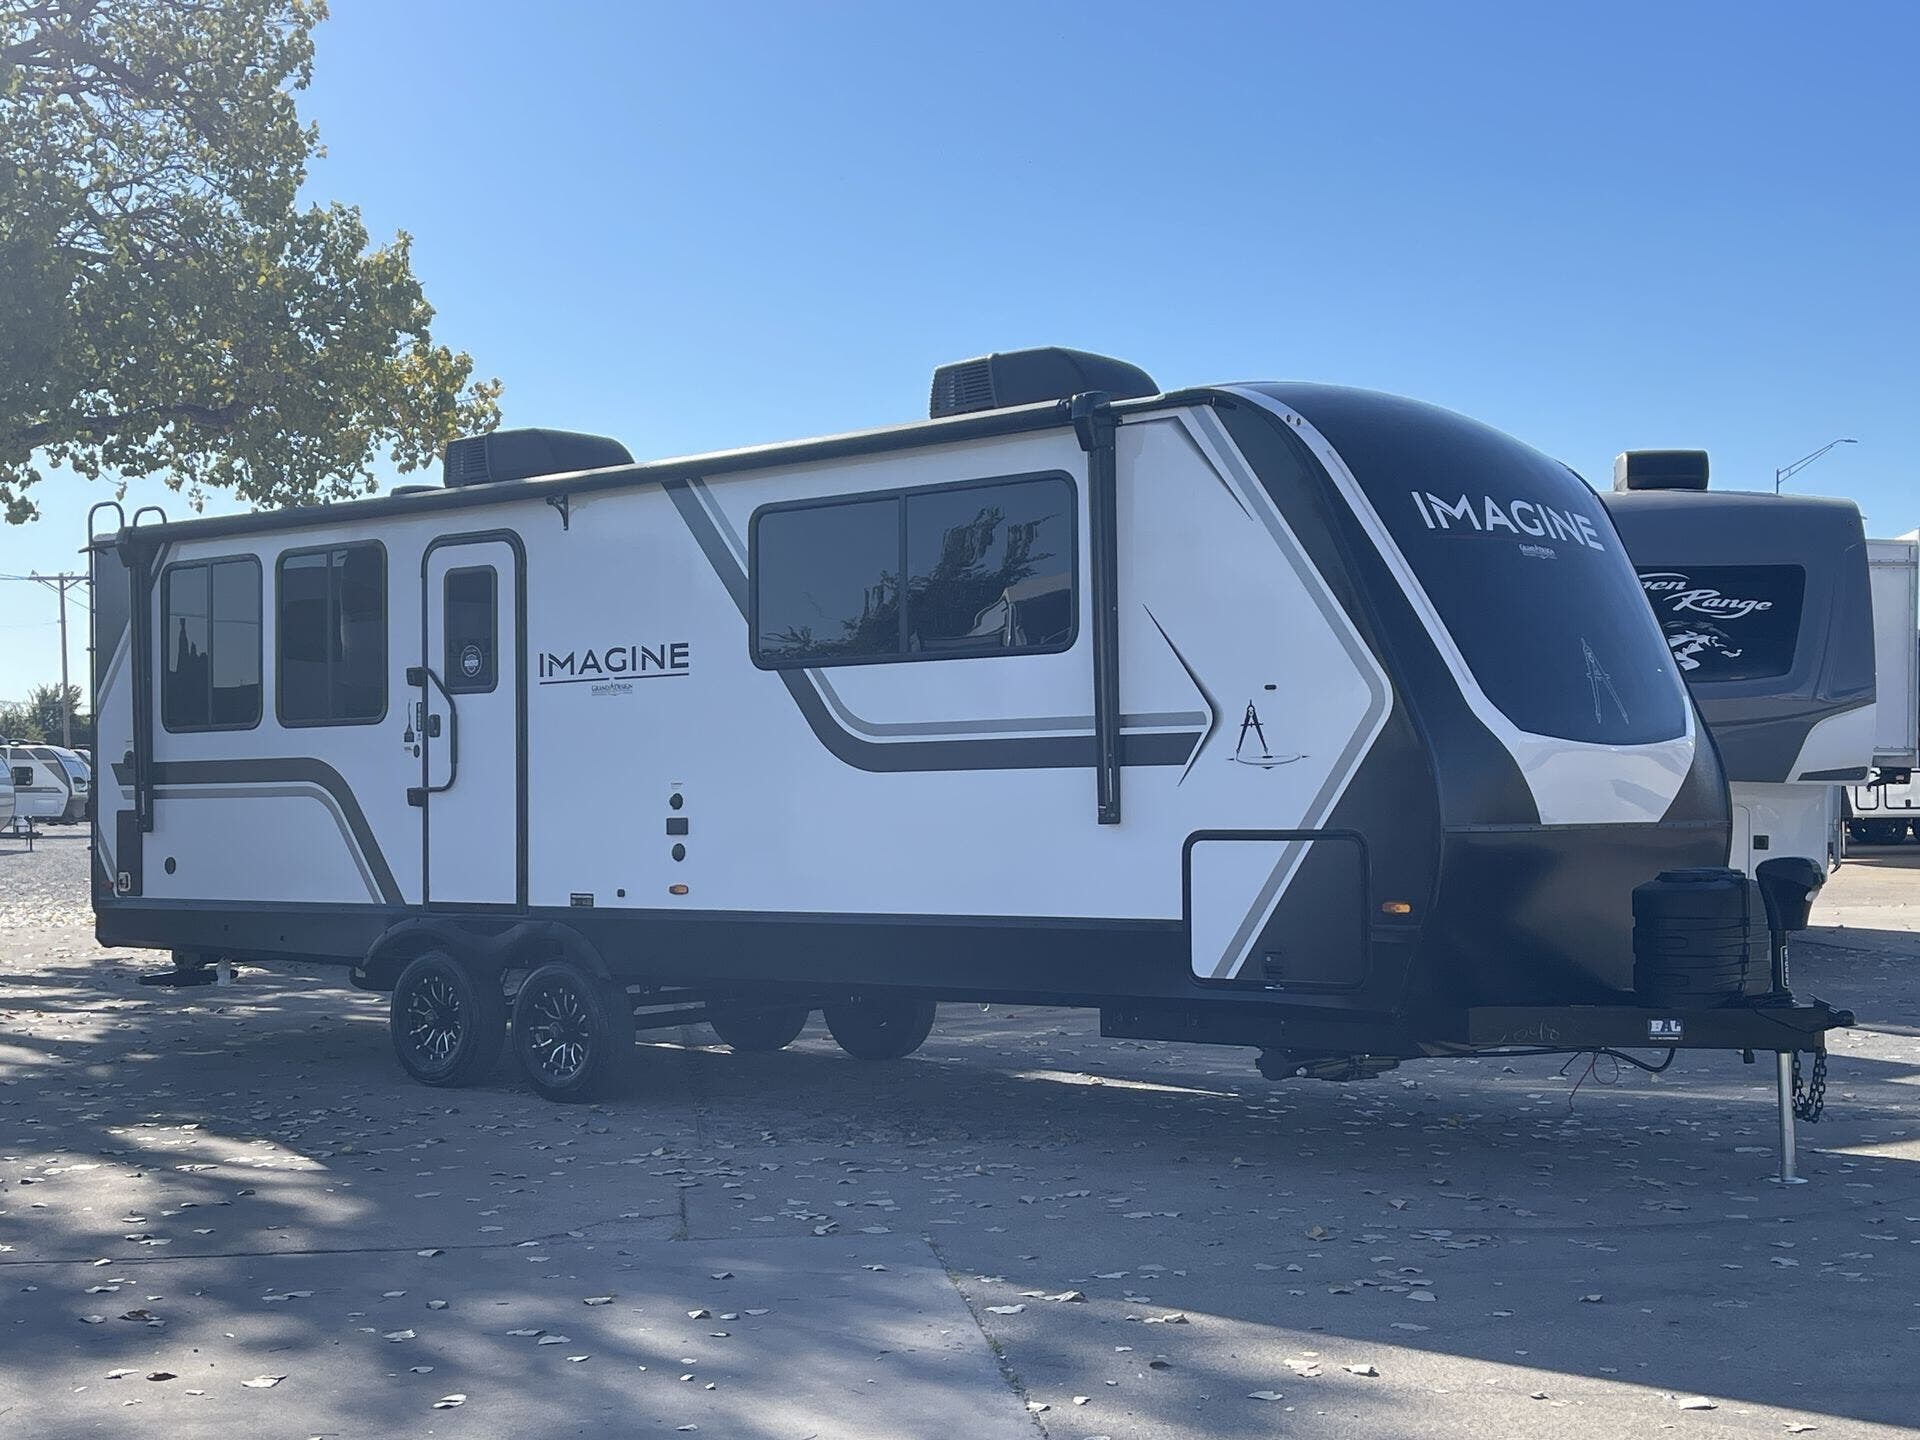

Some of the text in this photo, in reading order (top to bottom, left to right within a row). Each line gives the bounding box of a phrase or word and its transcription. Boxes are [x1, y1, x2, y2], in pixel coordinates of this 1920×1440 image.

[1411, 491, 1605, 551] IMAGINE
[1663, 589, 1773, 619] Range
[539, 642, 689, 677] IMAGINE
